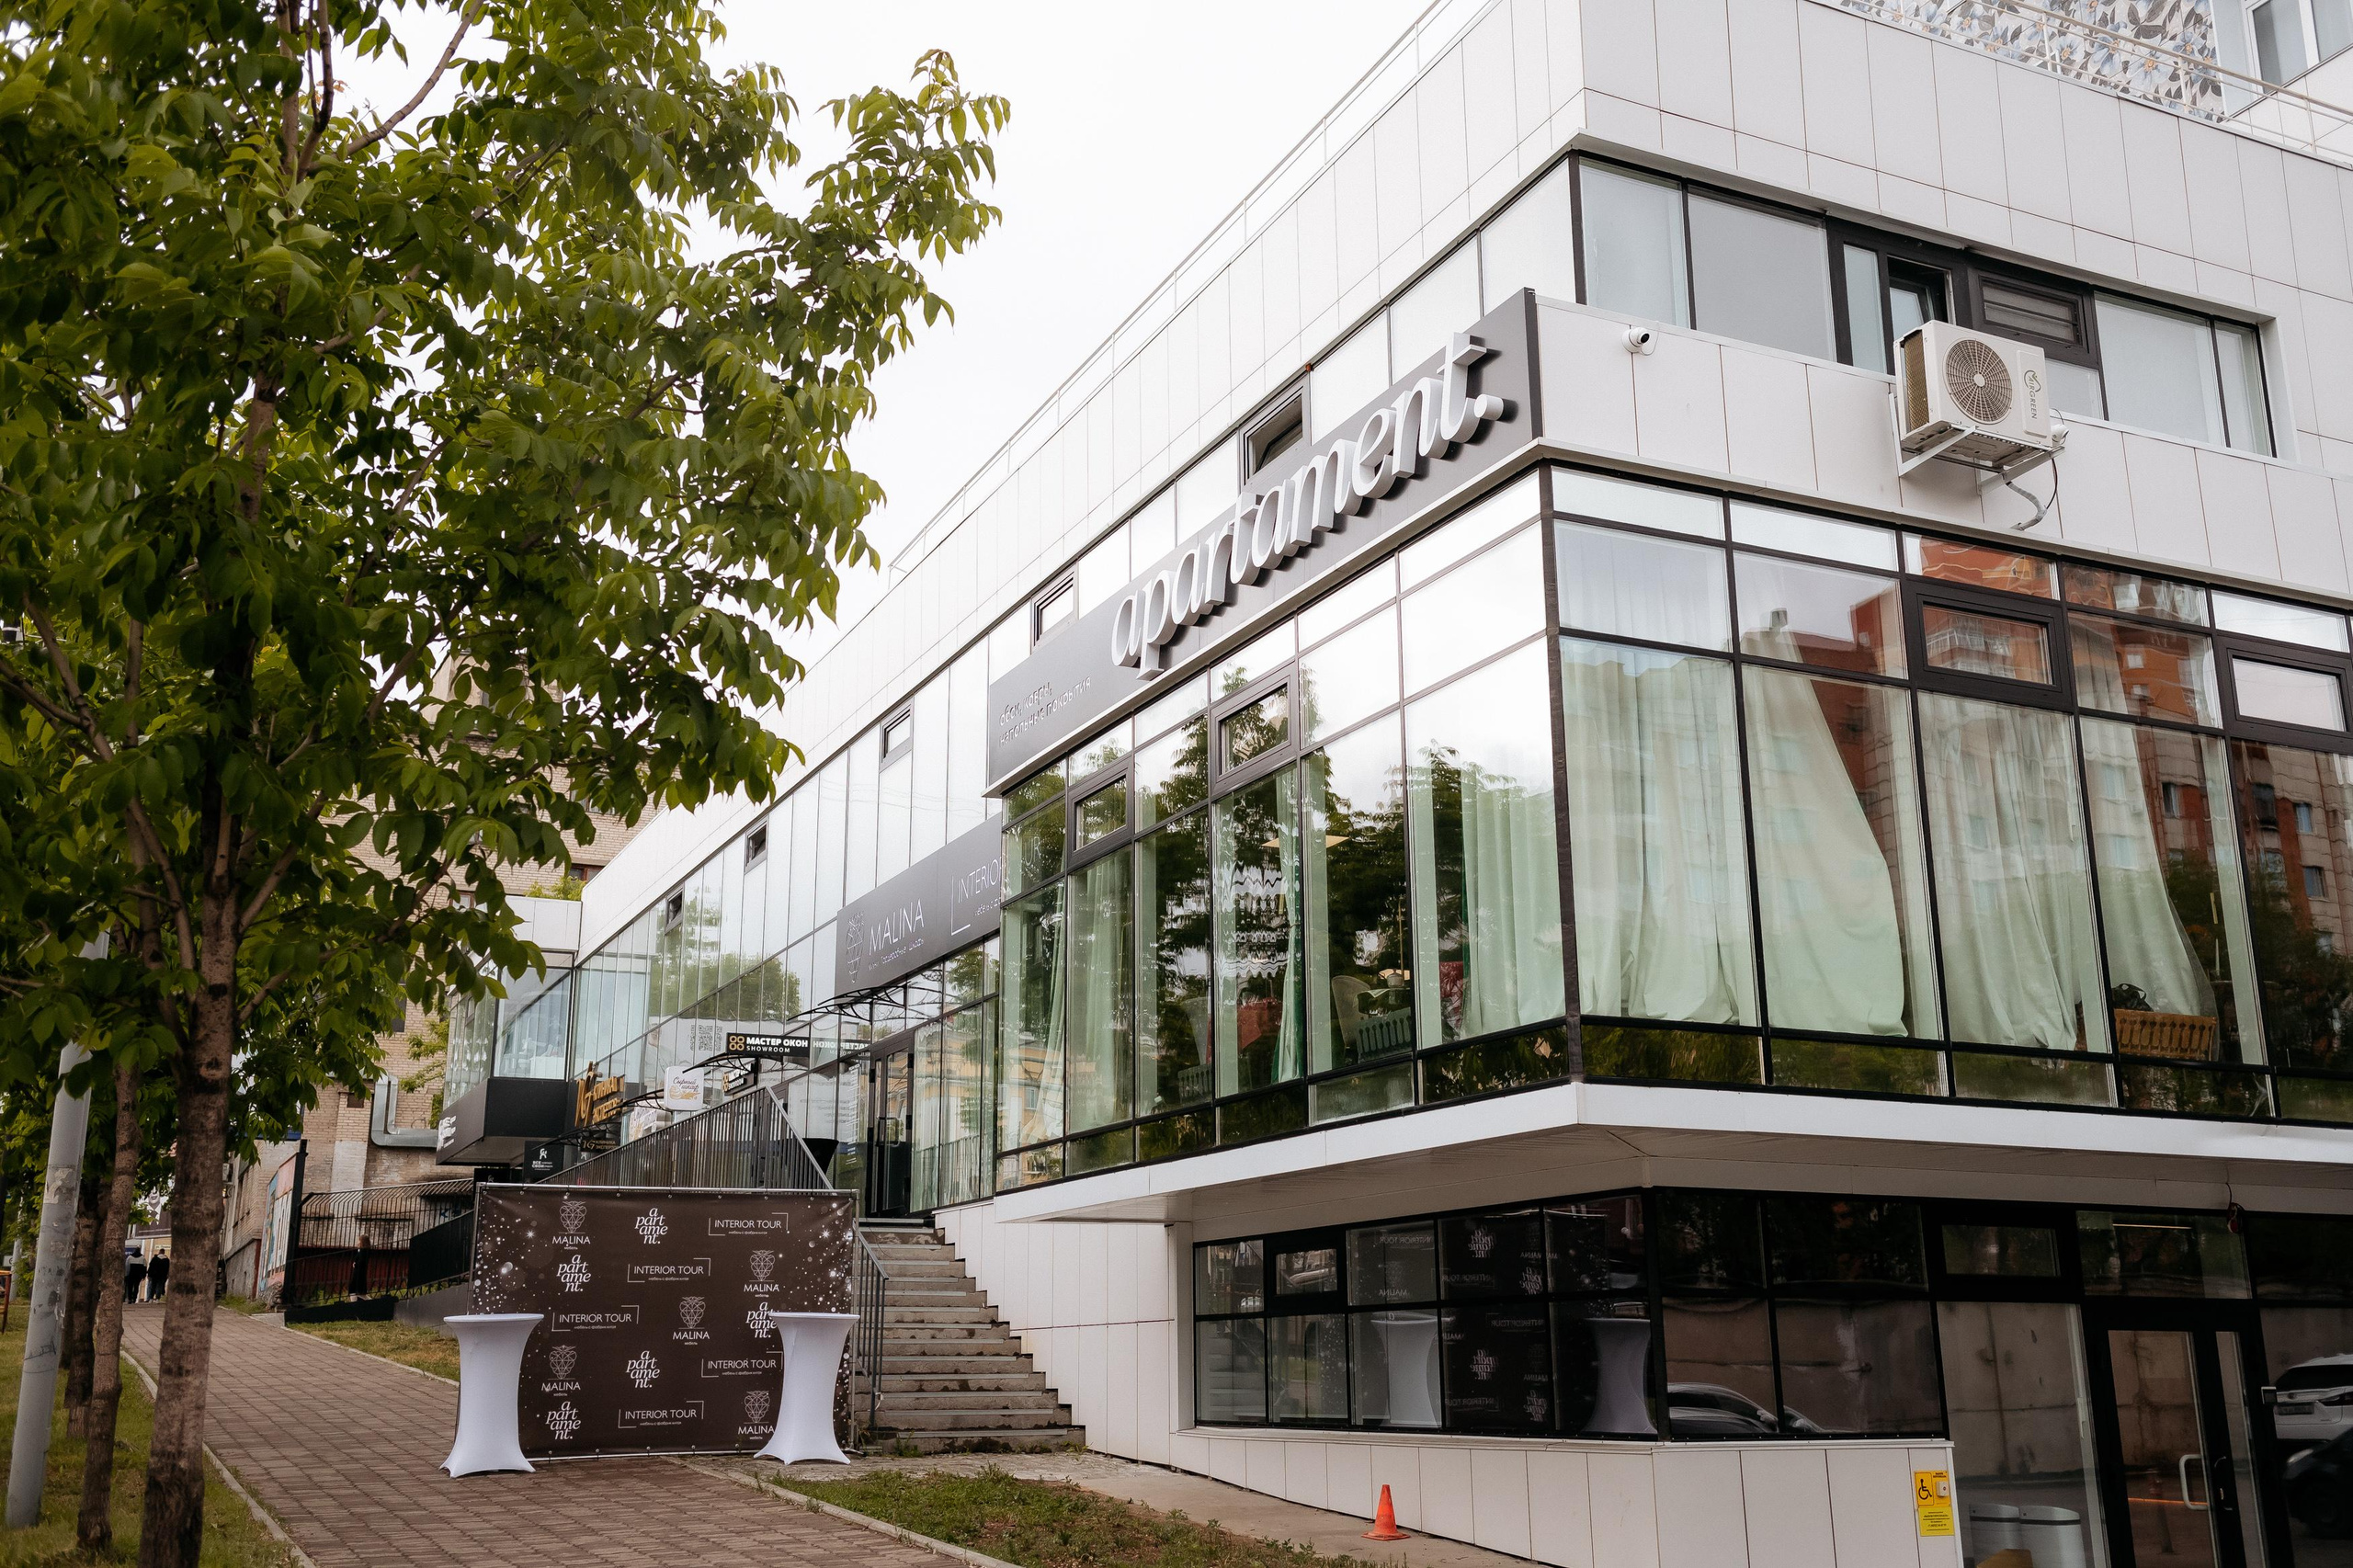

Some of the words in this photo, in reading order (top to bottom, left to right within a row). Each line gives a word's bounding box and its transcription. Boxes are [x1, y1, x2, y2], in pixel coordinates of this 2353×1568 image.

[2029, 375, 2037, 419] AIRGREEN
[1111, 332, 1505, 681] apartament.
[1046, 676, 1091, 716] покрытия
[869, 898, 925, 956] MALINA
[746, 1037, 782, 1047] МАСТЕР
[783, 1039, 809, 1048] ОКОН
[746, 1045, 790, 1053] SHOWROOM
[714, 1220, 755, 1229] INTERIOR
[757, 1220, 782, 1229] TOUR
[639, 1225, 668, 1235] ame
[551, 1235, 591, 1244] MALINA
[634, 1266, 676, 1275] INTERIOR
[677, 1266, 704, 1275] TOUR
[561, 1272, 592, 1282] ame
[744, 1284, 779, 1292] MALINA
[559, 1313, 602, 1324] INTERIOR
[605, 1313, 632, 1323] TOUR
[750, 1320, 778, 1329] ame
[673, 1331, 710, 1340] MALINA
[708, 1360, 749, 1369] INTERIOR
[751, 1359, 777, 1369] TOUR
[631, 1369, 660, 1379] ame
[541, 1381, 581, 1392] MALINA
[625, 1410, 668, 1420] INTERIOR
[670, 1410, 697, 1419] TOUR
[551, 1419, 581, 1430] ame
[738, 1426, 775, 1435] MALINA
